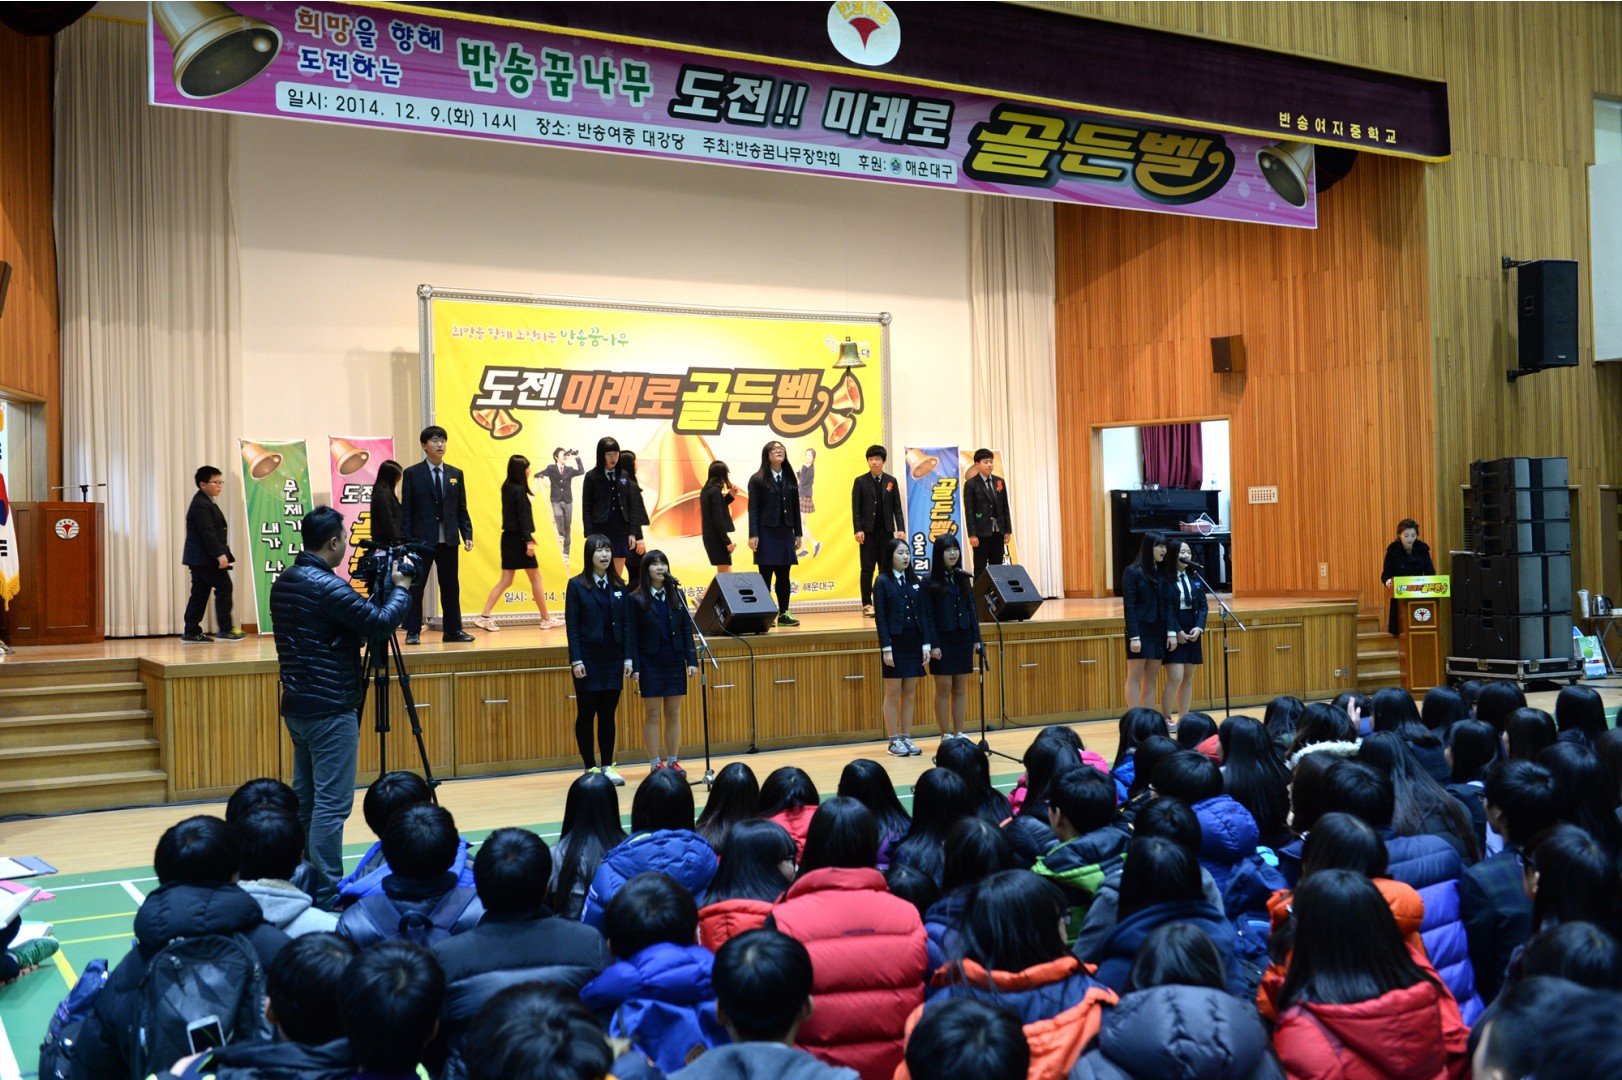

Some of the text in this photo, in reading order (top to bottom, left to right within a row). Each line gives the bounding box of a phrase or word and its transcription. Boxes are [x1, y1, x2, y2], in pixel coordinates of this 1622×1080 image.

[296, 8, 441, 52] 희망을 향해
[300, 48, 401, 85] 도전하는
[287, 88, 328, 111] 일시:
[335, 95, 385, 116] 2014.
[395, 102, 420, 120] 12.
[430, 106, 475, 128] 9.(화)
[482, 112, 517, 132] 14시
[536, 117, 571, 136] 장소:
[577, 122, 636, 146] 반송여중
[642, 130, 686, 151] 대강당
[858, 154, 887, 172] 후원:
[905, 160, 953, 180] 해운대구
[460, 42, 1226, 196] 반송꿈나무 도전!! 미래로 골든벨
[1279, 111, 1397, 144] 반송여자중학교
[452, 325, 630, 347] 희망을 향해 도전하는 반송꿈나무
[475, 369, 830, 435] 도전! 미래로 골든벨
[929, 477, 958, 543] 골든벨
[504, 591, 528, 603] 일시:
[803, 581, 835, 592] 해운대구
